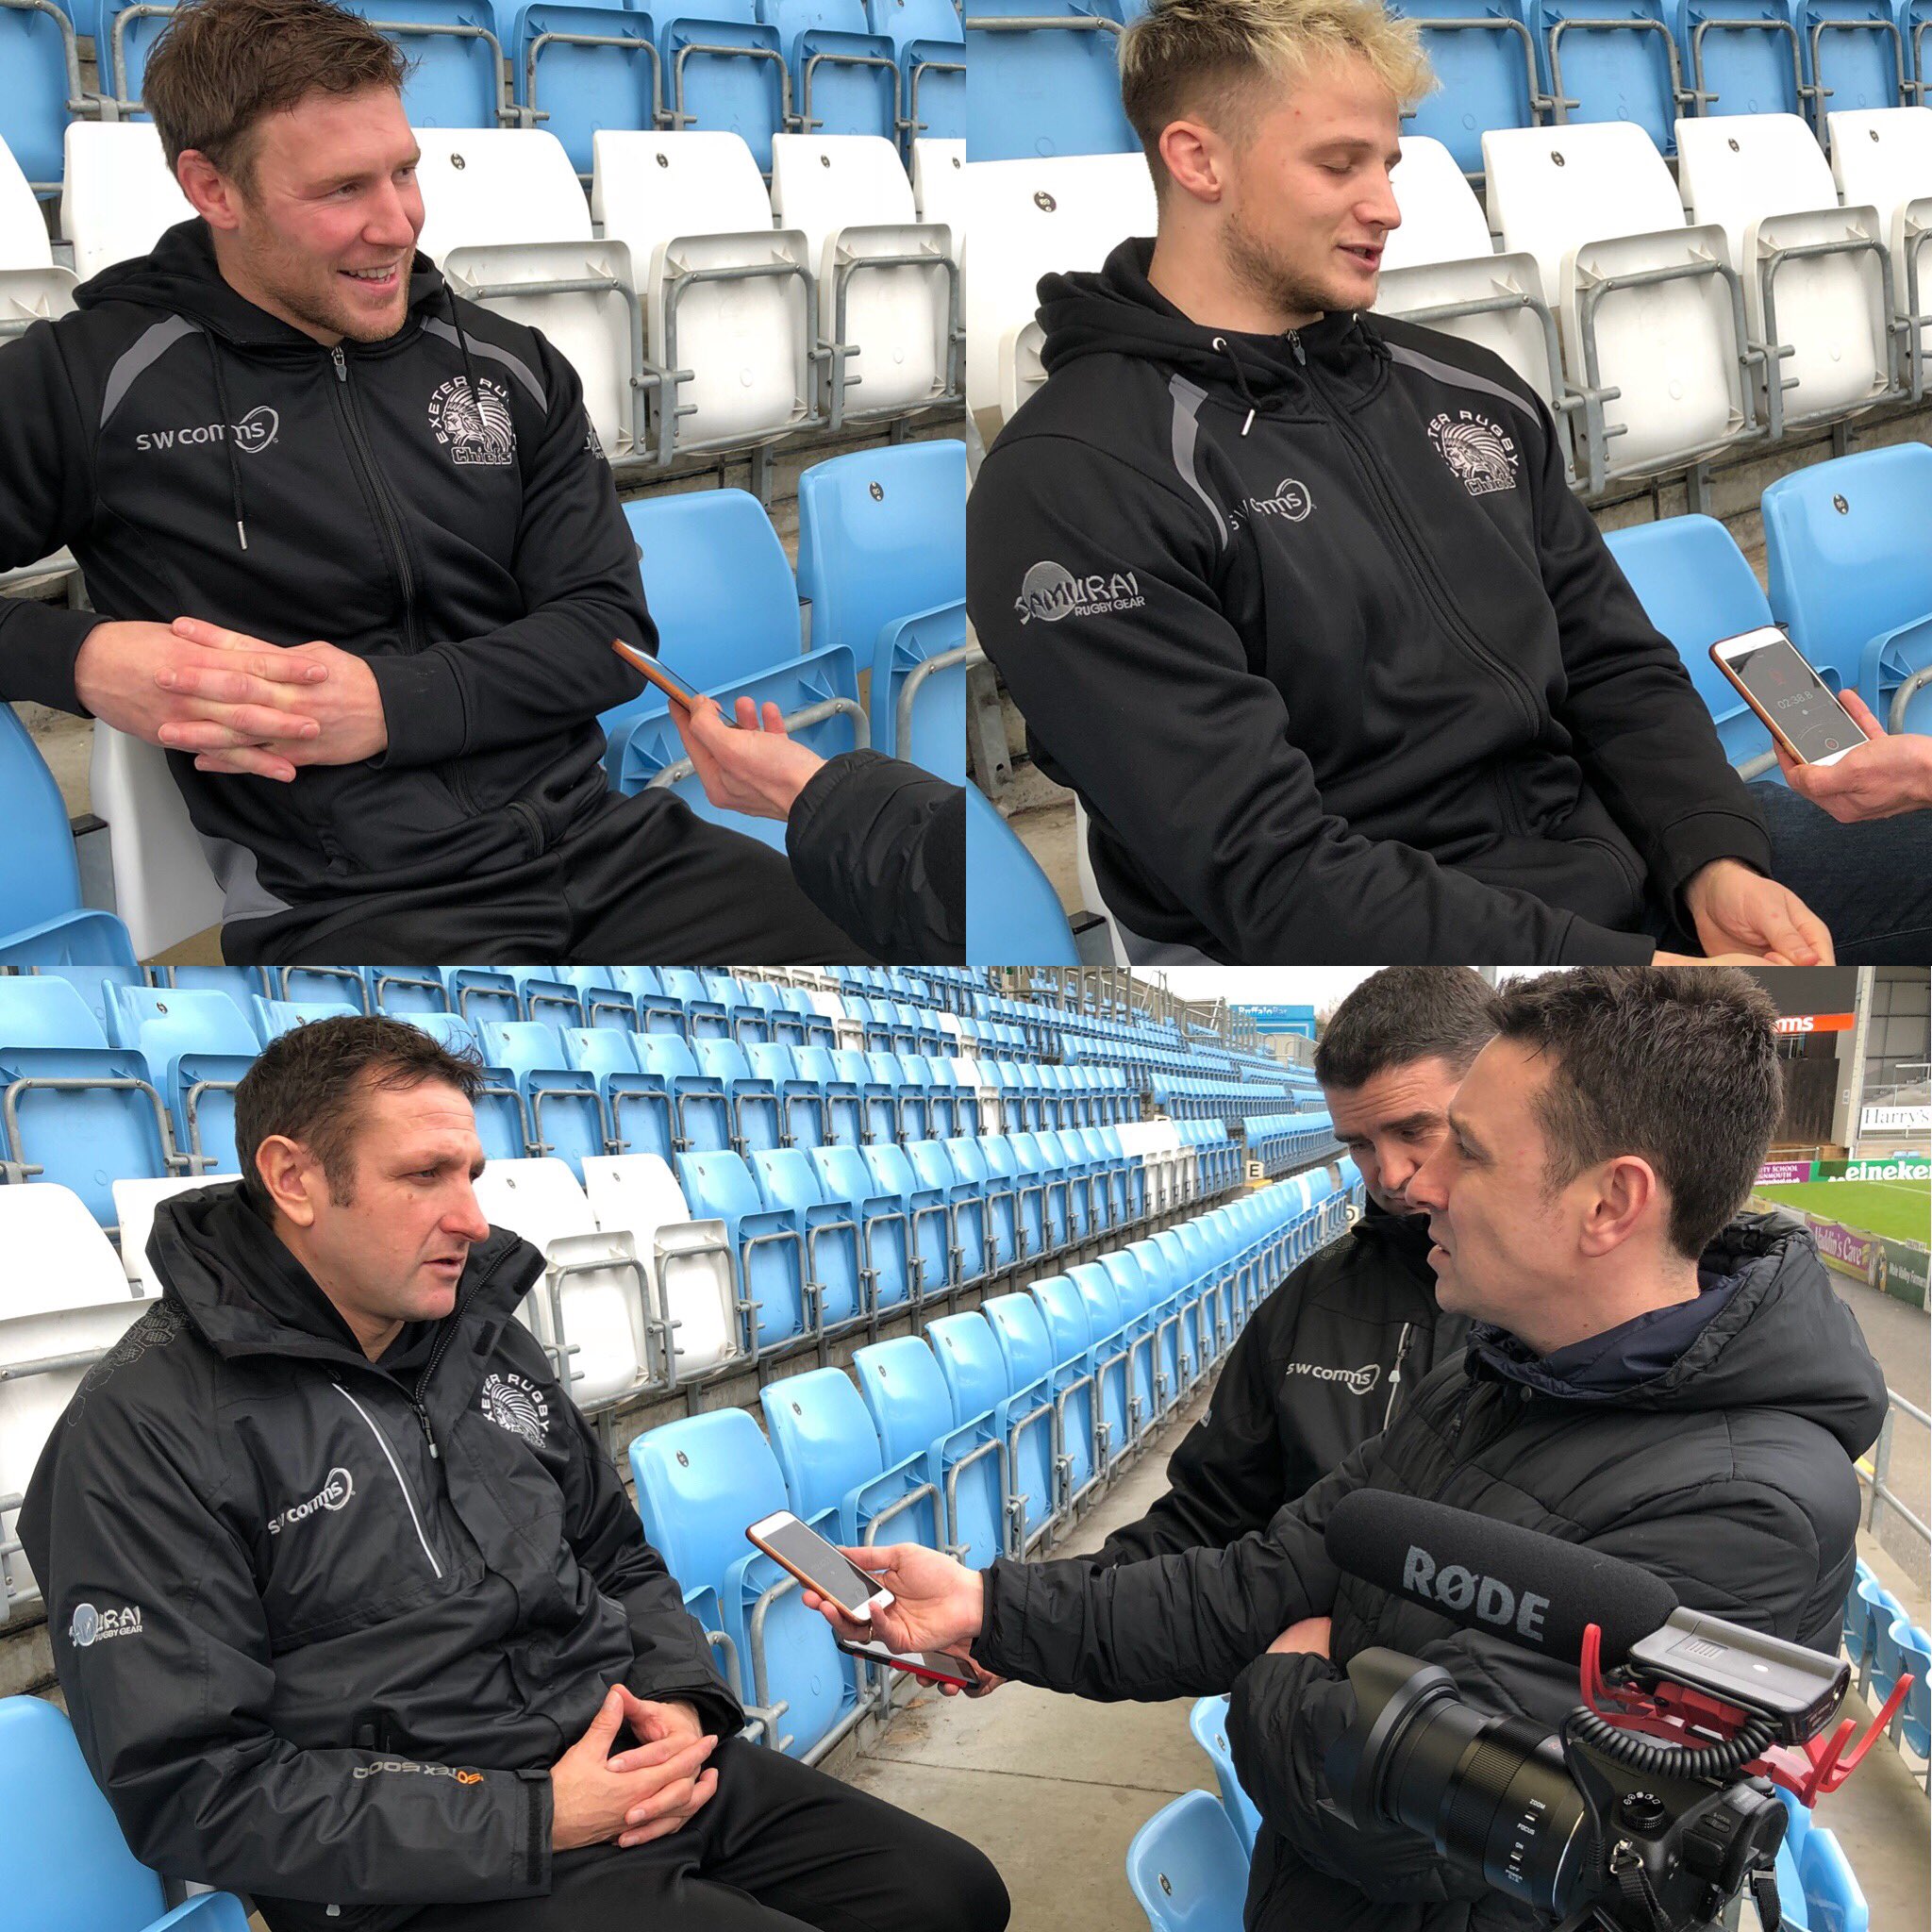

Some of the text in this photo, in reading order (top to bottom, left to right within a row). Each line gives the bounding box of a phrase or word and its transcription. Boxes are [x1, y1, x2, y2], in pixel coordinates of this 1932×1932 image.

[428, 375, 468, 444] EXETER
[1459, 410, 1519, 466] RUGBY
[1013, 571, 1139, 625] SAMURAI
[1074, 595, 1146, 617] RUGBY GEAR
[1865, 1108, 1929, 1127] Harry's
[1250, 1163, 1259, 1177] E
[1773, 1164, 1798, 1173] SCHOOL
[1827, 1160, 1931, 1182] eineke
[481, 1373, 550, 1432] XETER RUGBY
[119, 1624, 143, 1636] GEAR
[1529, 1798, 1546, 1809] ZOOM
[1517, 1823, 1536, 1836] FOCUS
